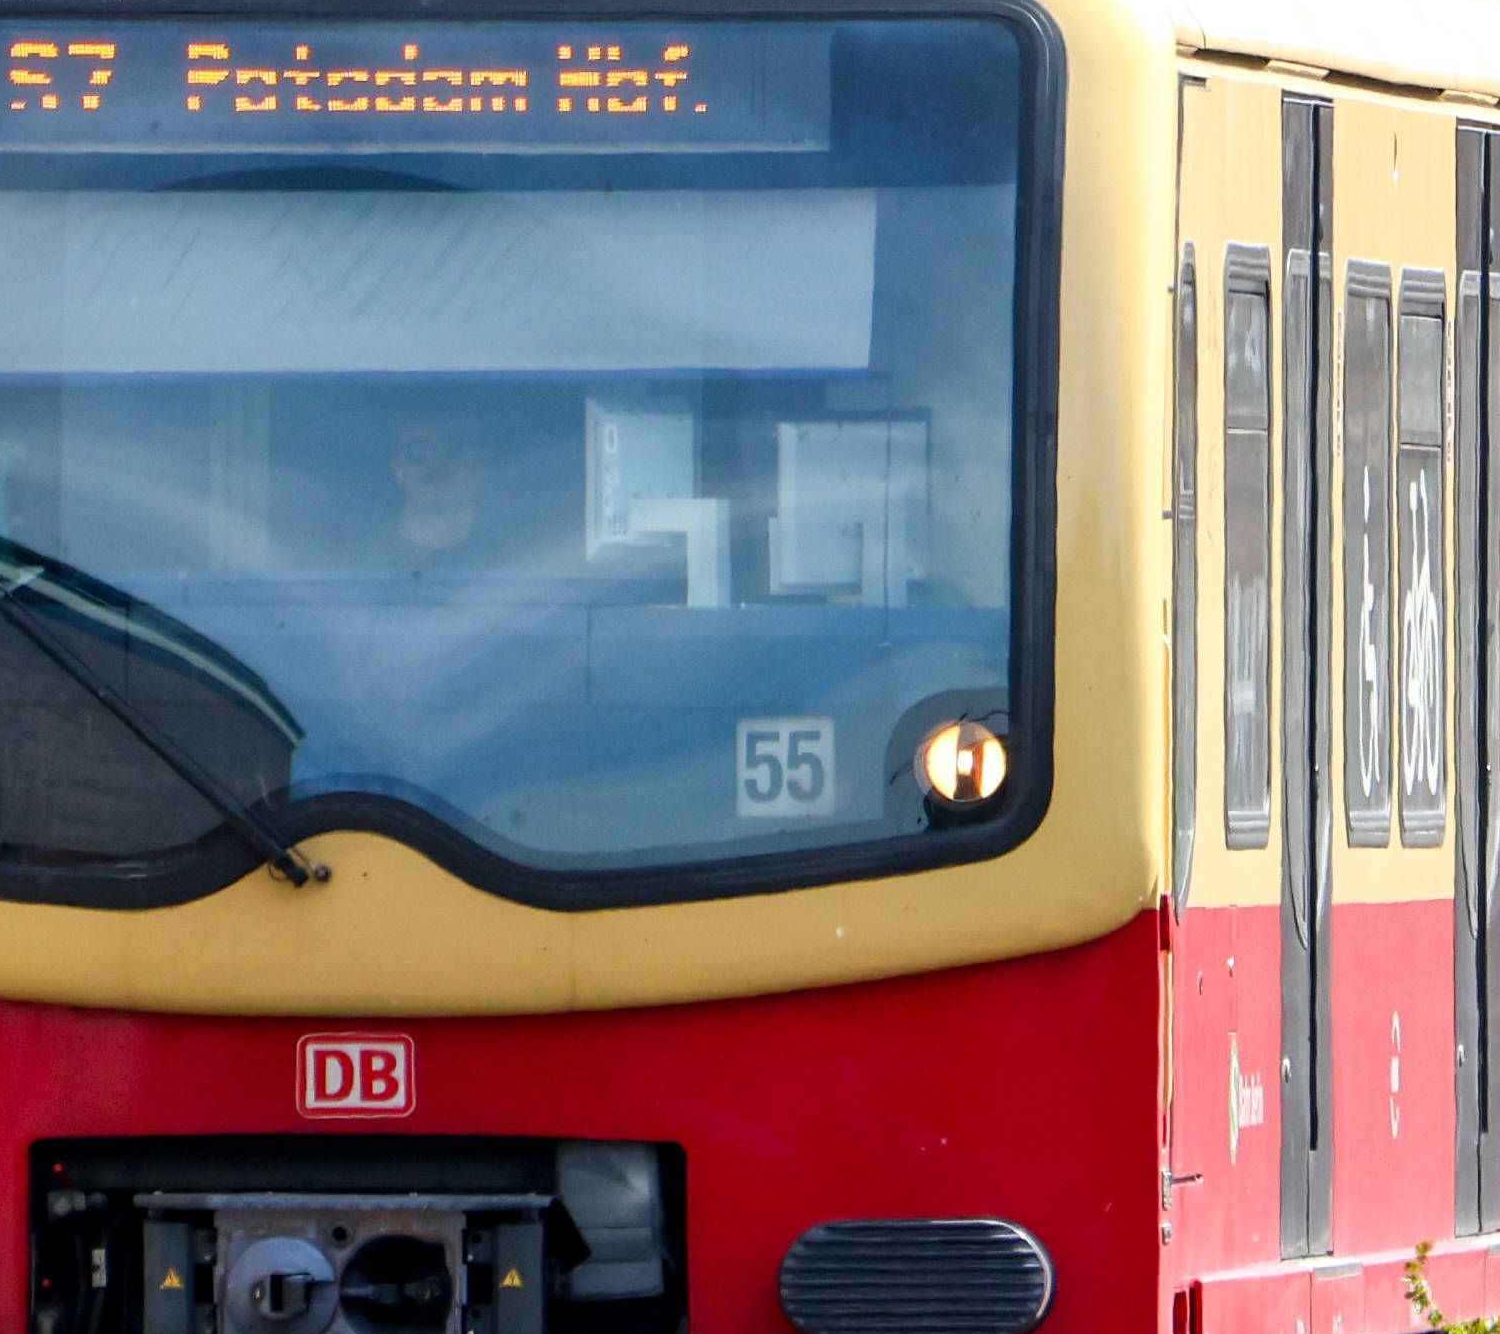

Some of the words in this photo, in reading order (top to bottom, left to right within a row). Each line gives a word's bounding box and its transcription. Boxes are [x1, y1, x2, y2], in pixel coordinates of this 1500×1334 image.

[9, 42, 117, 110] S7
[186, 42, 528, 112] Potsdam
[744, 730, 825, 803] 55
[311, 1047, 402, 1104] DB
